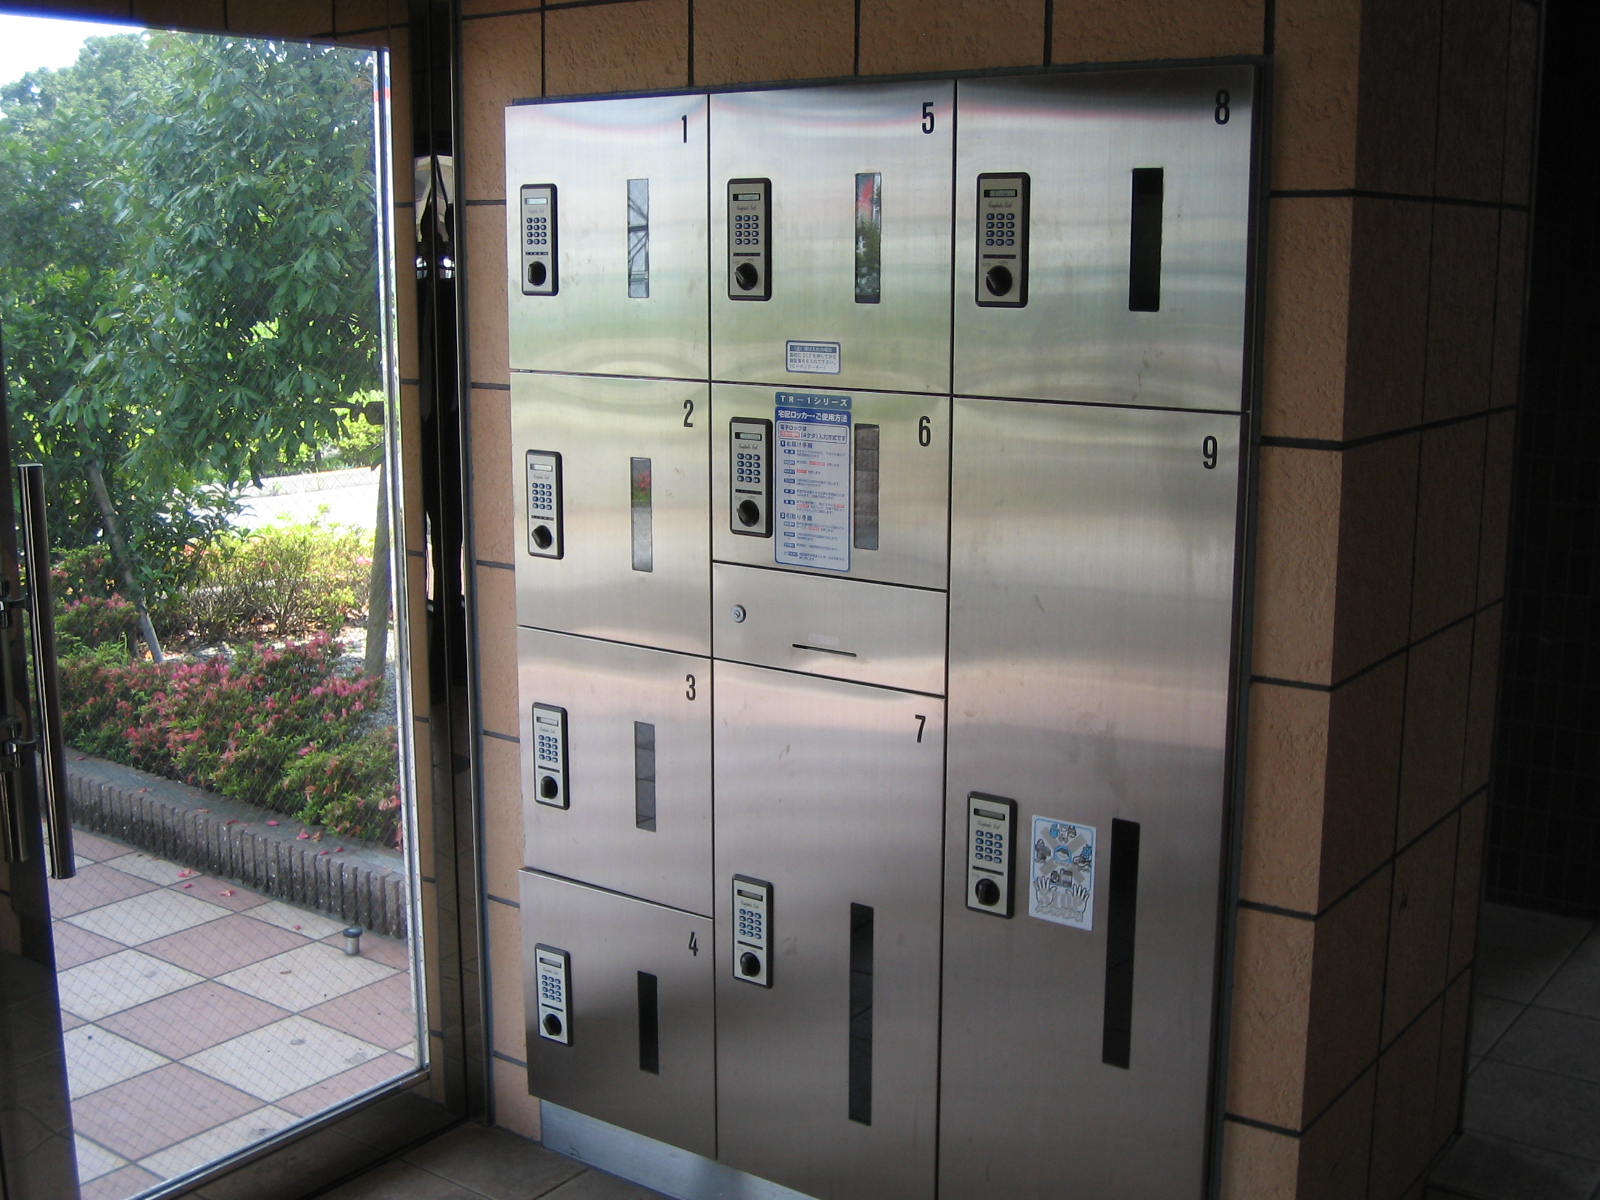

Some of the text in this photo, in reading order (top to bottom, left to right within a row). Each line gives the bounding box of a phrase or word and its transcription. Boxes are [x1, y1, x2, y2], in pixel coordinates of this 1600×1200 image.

[921, 101, 935, 135] 5
[1214, 88, 1230, 125] 8
[681, 114, 688, 144] 1
[683, 399, 694, 428] 2
[918, 415, 931, 447] 6
[1202, 435, 1218, 470] 9
[685, 673, 696, 701] 3
[915, 714, 926, 744] 7
[688, 931, 699, 957] 4
